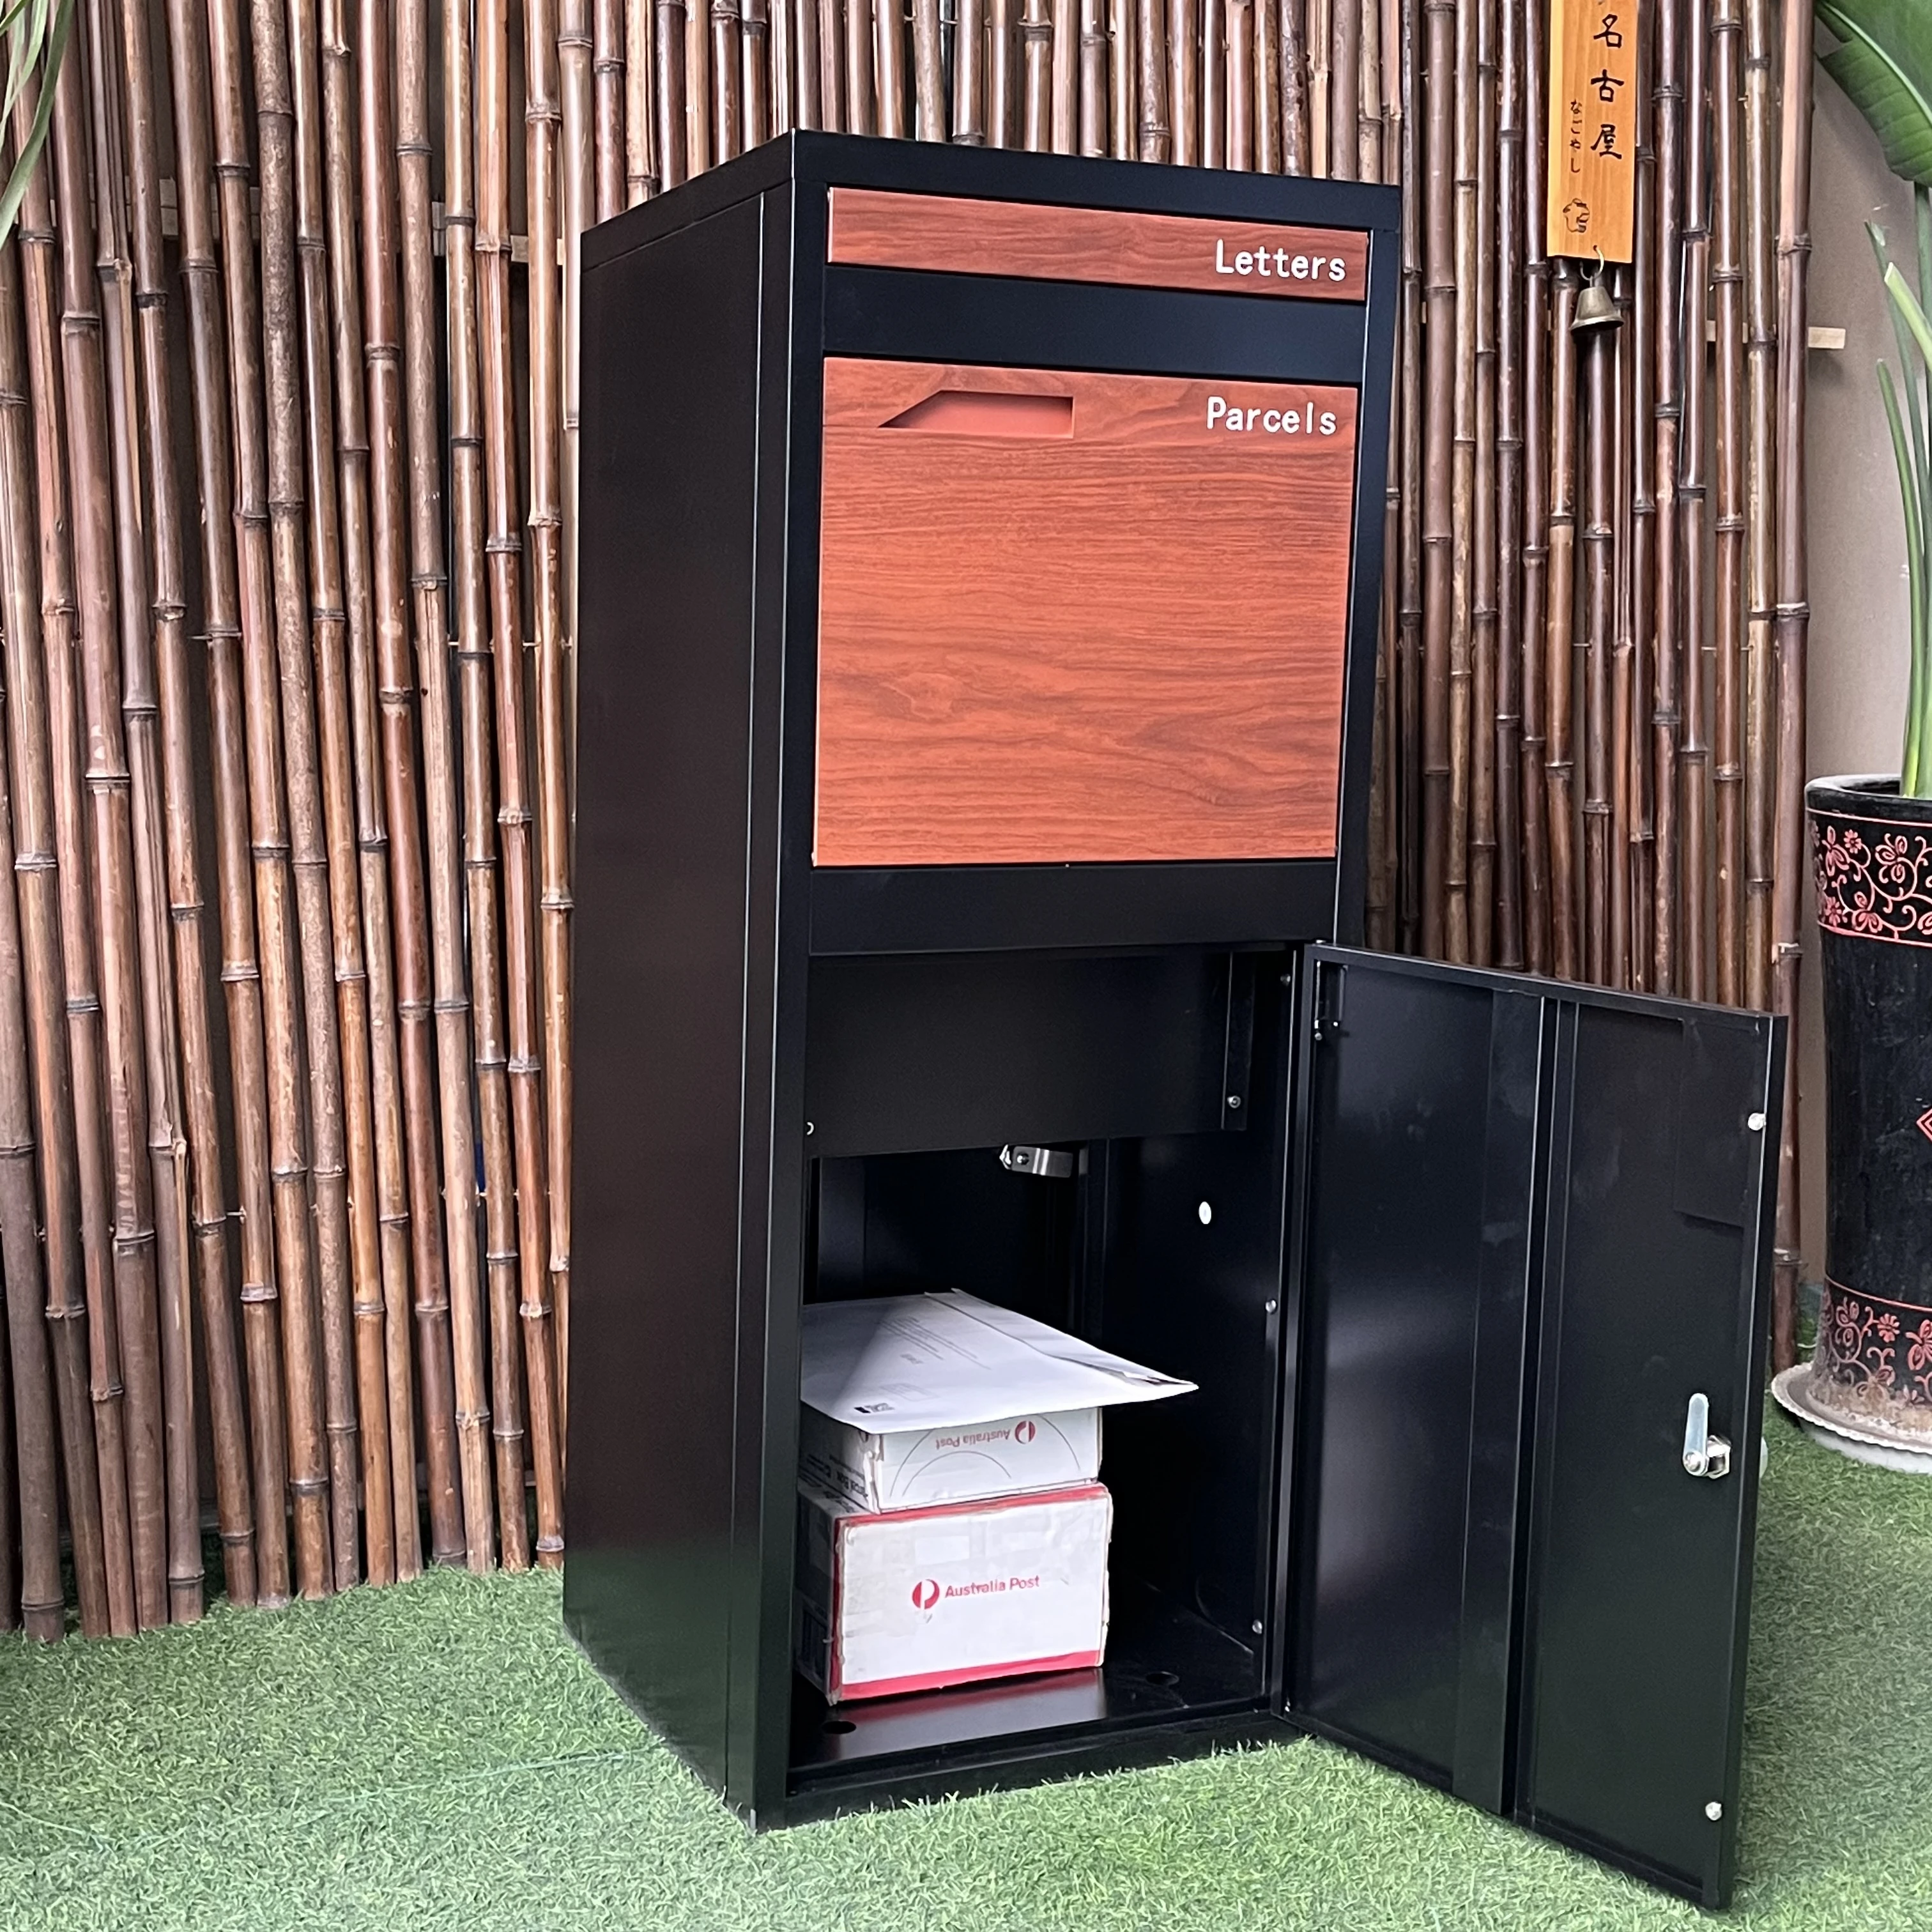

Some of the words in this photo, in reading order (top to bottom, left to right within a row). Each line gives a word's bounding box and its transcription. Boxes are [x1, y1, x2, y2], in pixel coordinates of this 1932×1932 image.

[1590, 13, 1625, 160] 名古屋
[1215, 238, 1346, 282] Letters
[1206, 395, 1337, 436] Parcels
[935, 1436, 960, 1450] Post
[963, 1428, 1011, 1446] Australia
[945, 1579, 1006, 1598] Australia
[1009, 1575, 1040, 1591] Post
